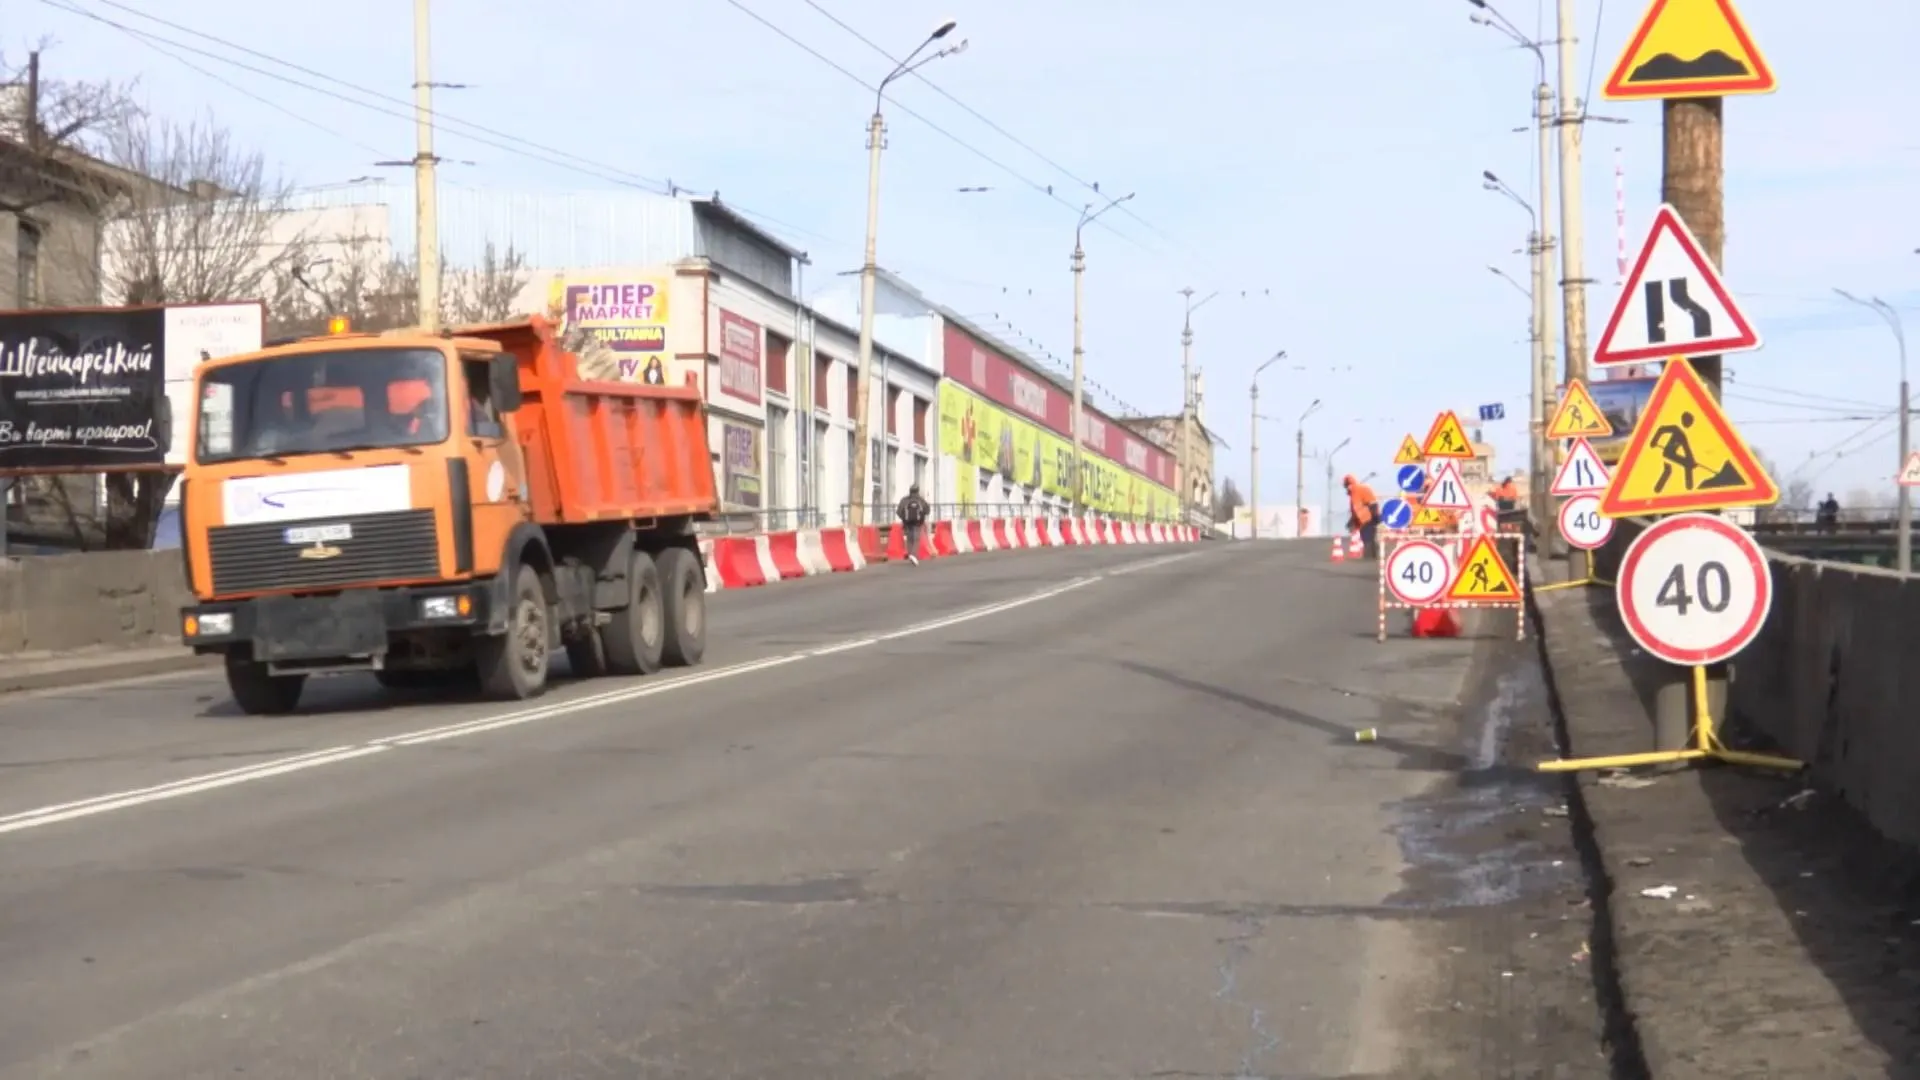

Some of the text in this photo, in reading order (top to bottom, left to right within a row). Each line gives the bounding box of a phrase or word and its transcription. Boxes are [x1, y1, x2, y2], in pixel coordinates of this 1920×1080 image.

[579, 306, 652, 320] МАРКЕТ
[0, 337, 152, 383] Швейцарський
[26, 421, 71, 446] варті
[75, 418, 152, 445] кращого!
[1574, 511, 1600, 530] 40
[1402, 561, 1433, 584] 40
[1656, 561, 1731, 615] 40
